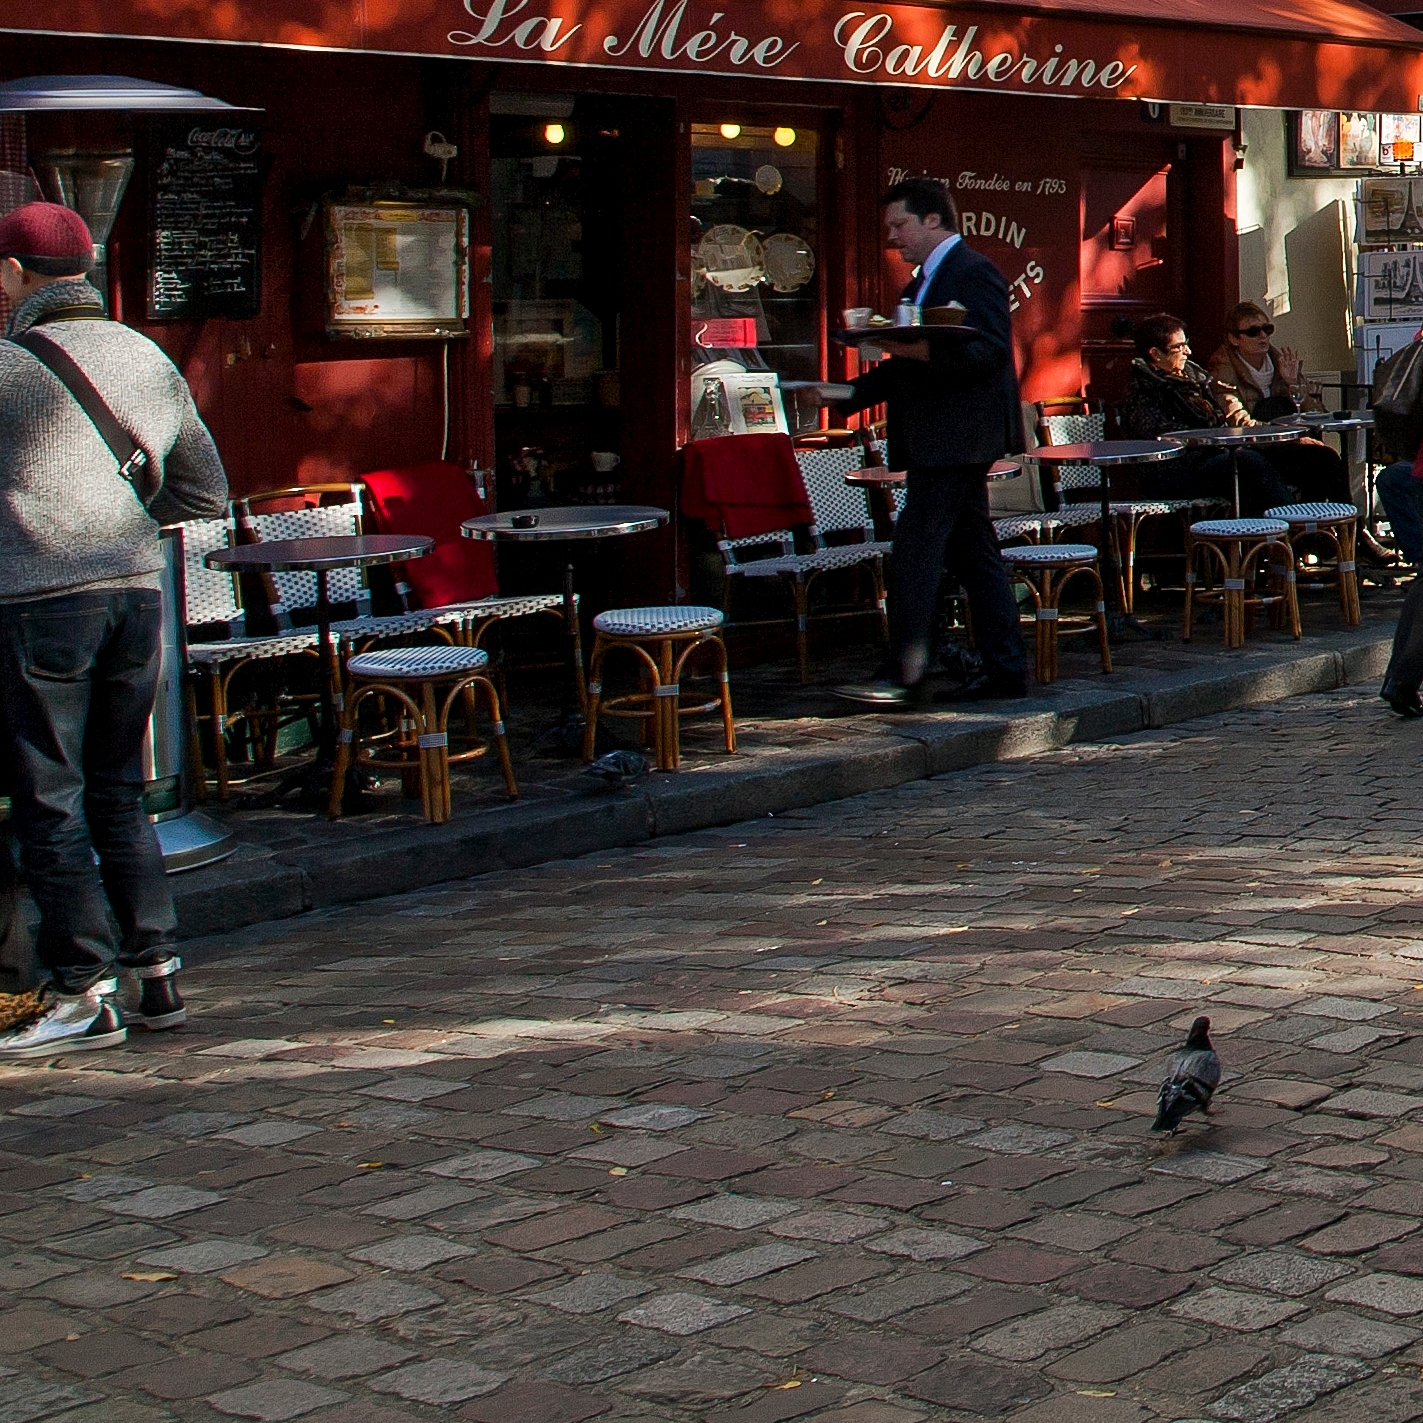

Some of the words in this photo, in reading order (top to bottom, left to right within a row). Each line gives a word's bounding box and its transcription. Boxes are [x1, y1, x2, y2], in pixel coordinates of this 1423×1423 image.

[833, 11, 1140, 89] Catherine
[956, 171, 1010, 193] Fondée
[1015, 181, 1033, 193] en
[1036, 178, 1067, 195] 1793
